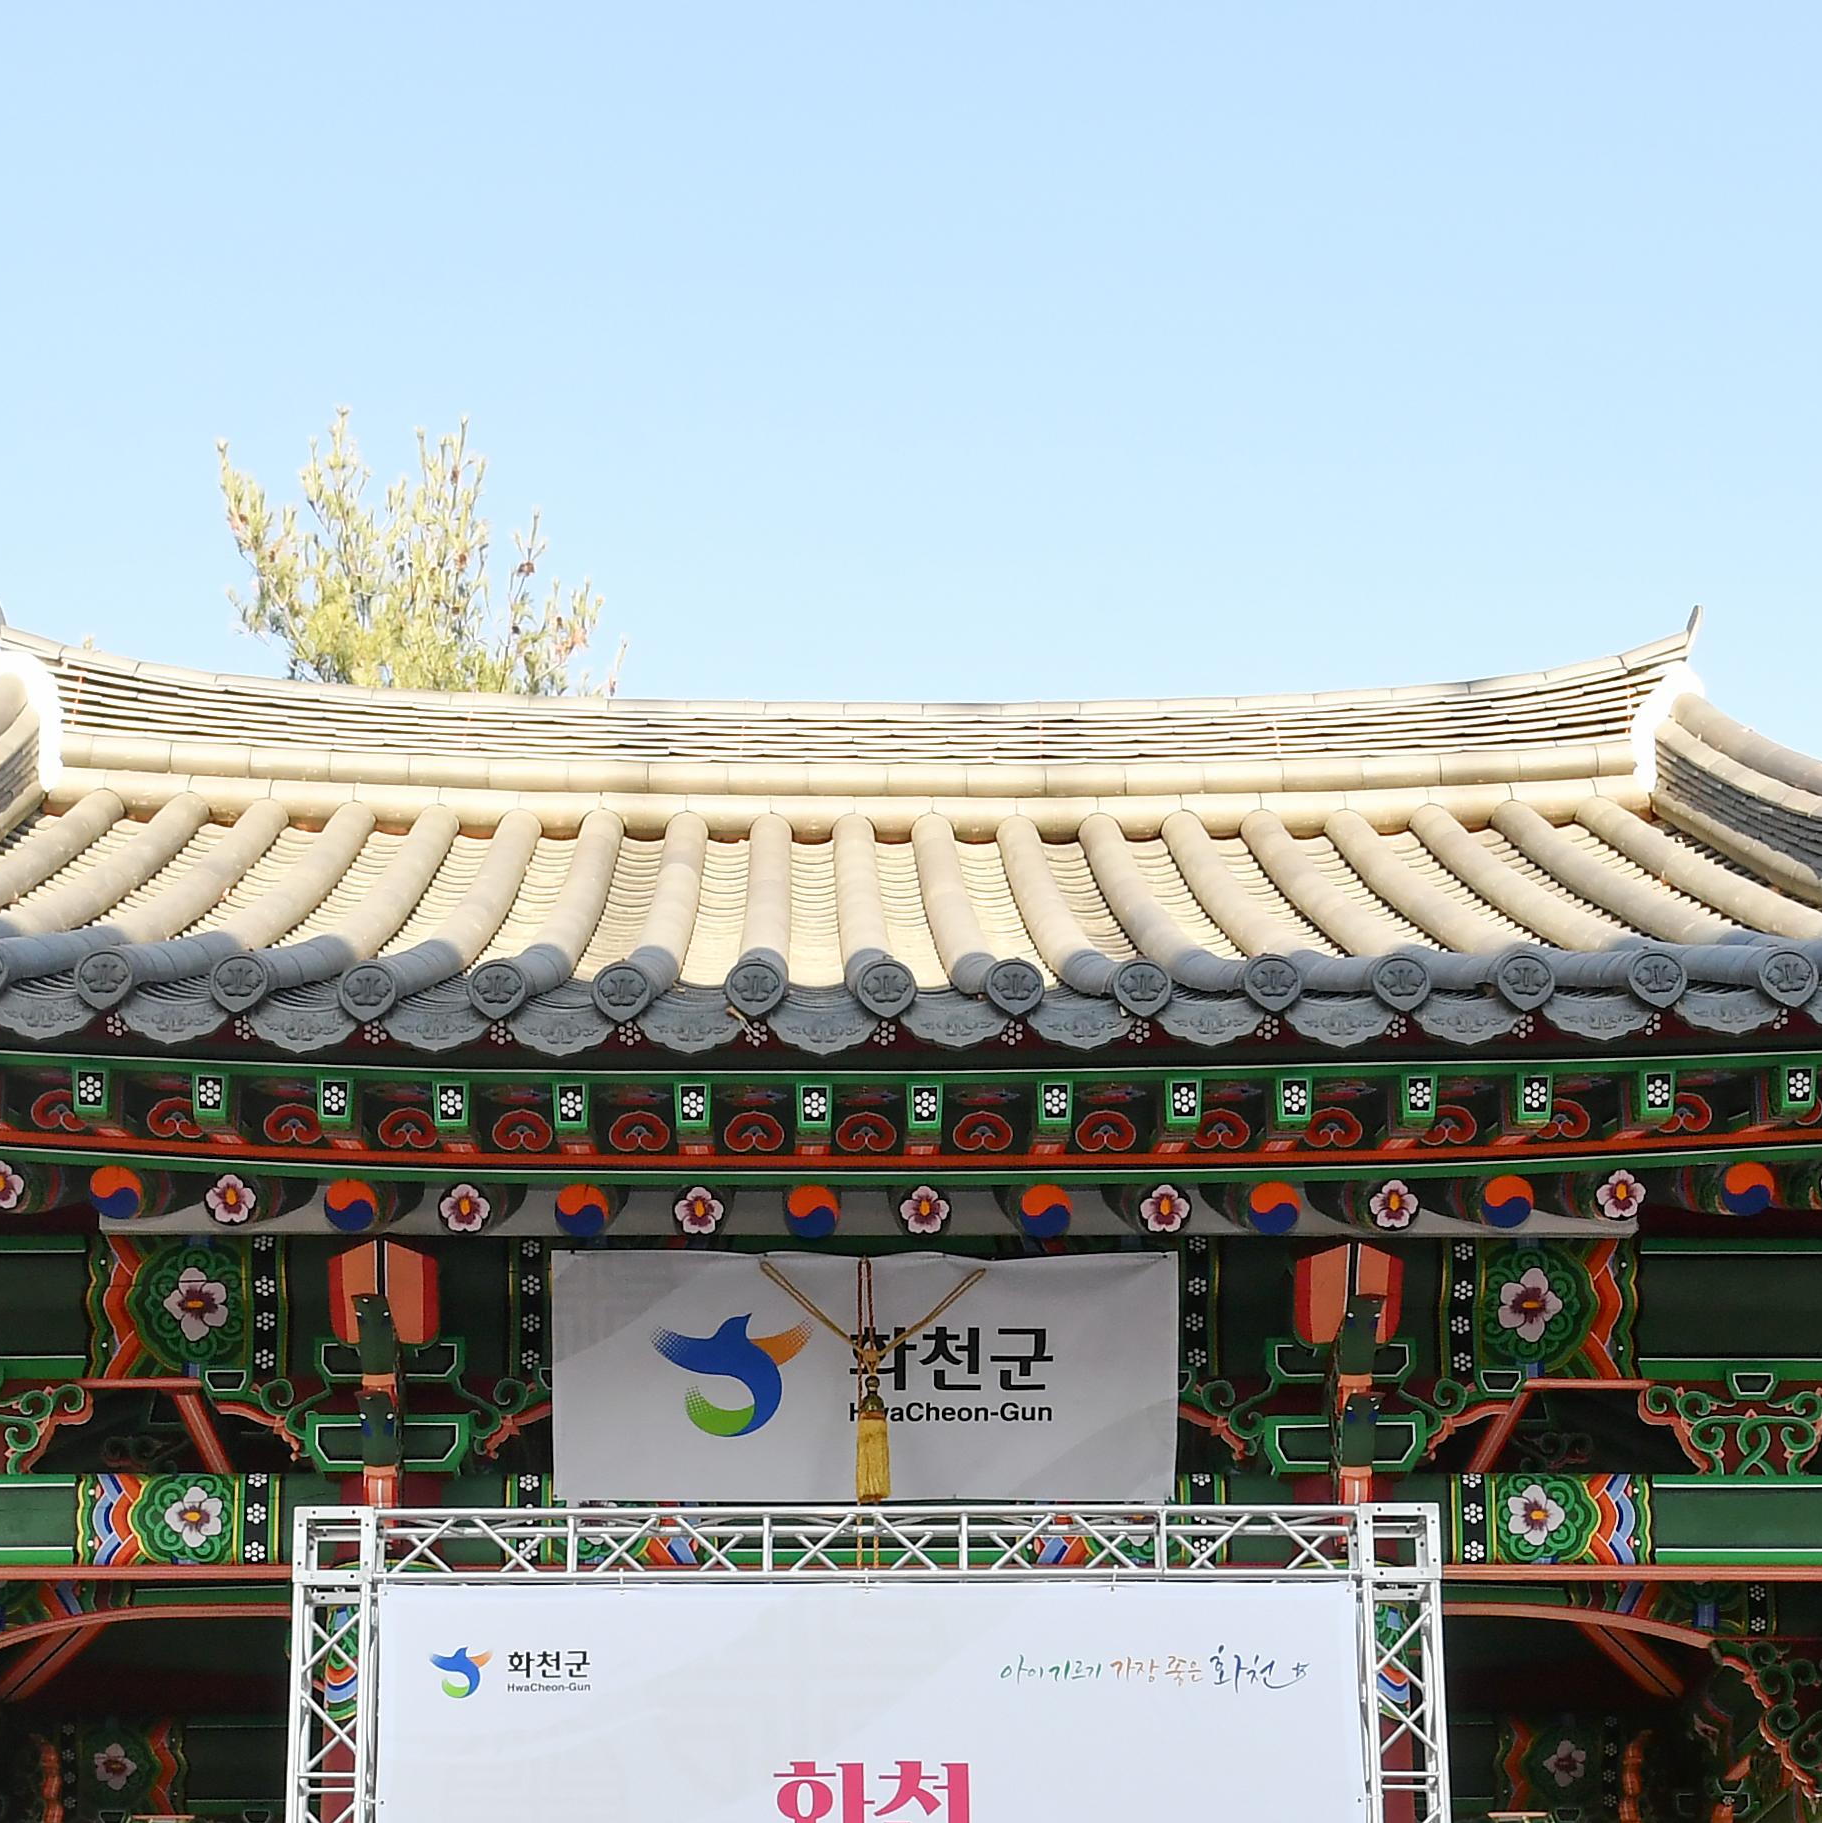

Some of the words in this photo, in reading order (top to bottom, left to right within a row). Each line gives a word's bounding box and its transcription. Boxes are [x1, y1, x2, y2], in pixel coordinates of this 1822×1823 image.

[849, 1326, 1054, 1391] 화천군
[508, 1651, 590, 1678] 화천군
[1110, 1657, 1159, 1682] 가장
[1165, 1656, 1202, 1686] 좋은
[1210, 1645, 1292, 1693] 화천
[508, 1683, 590, 1692] HwaCheon-Gun
